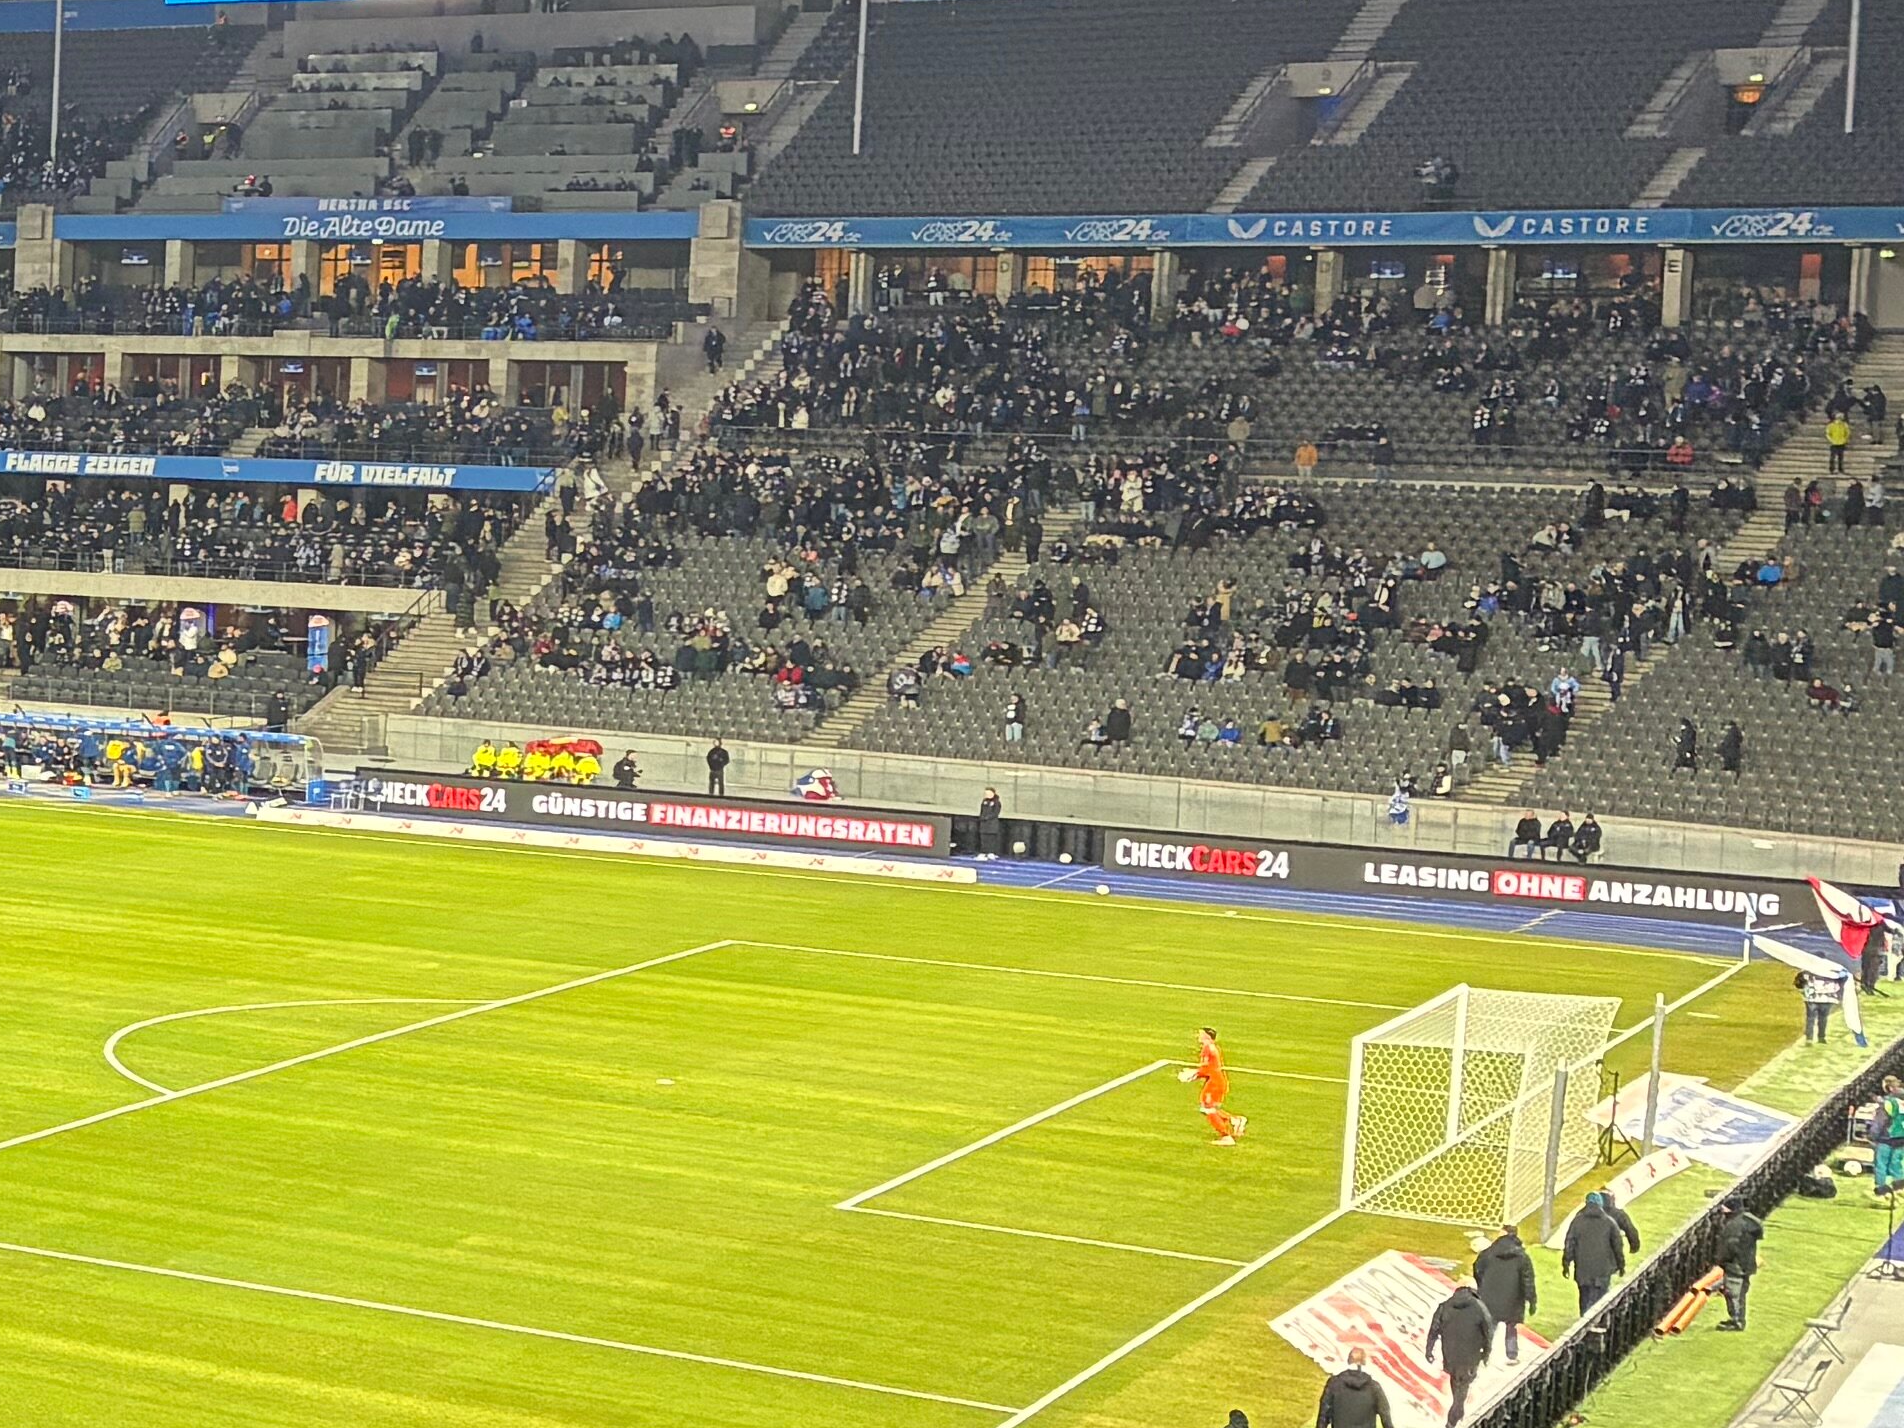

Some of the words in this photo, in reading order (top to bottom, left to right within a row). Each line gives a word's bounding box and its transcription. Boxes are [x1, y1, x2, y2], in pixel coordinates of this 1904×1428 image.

[283, 216, 317, 236] Die
[319, 215, 373, 238] Alte
[376, 217, 445, 237] Dame
[1273, 220, 1393, 237] CASTORE
[1522, 217, 1650, 235] CASTORE
[5, 453, 81, 473] FLAGGE
[314, 460, 354, 483] FÜR
[360, 464, 457, 486] VIELFALT
[532, 792, 647, 822] GÜNSTIGE
[651, 803, 934, 848] FINANZIERUNGSRATEN
[1115, 838, 1289, 880] CHECKCARS24
[1364, 862, 1489, 892] LEASING
[1496, 873, 1583, 899] OHNE
[1589, 880, 1780, 916] ANZAHLUNG
